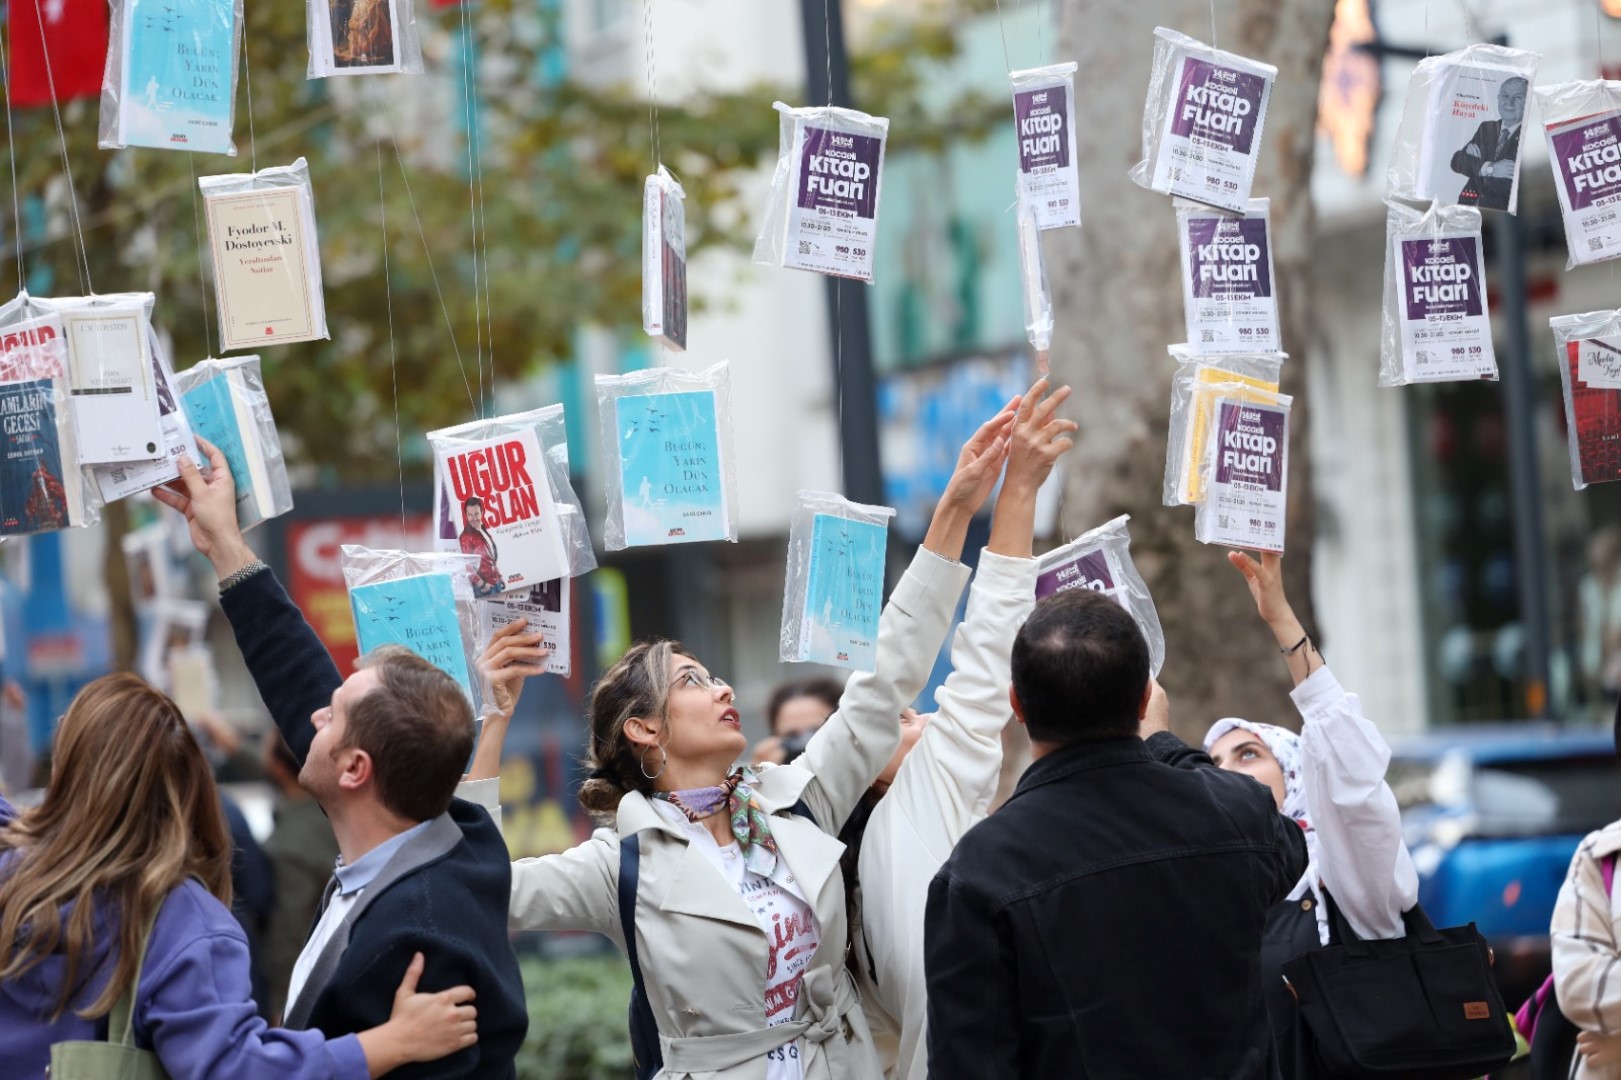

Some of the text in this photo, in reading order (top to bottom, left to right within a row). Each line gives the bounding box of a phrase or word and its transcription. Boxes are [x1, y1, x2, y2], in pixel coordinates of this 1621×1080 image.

[1186, 84, 1250, 116] Kitap
[1021, 113, 1062, 136] Kitap
[809, 154, 869, 182] Kitap
[1567, 142, 1621, 173] Kita
[1205, 175, 1238, 190] 980 530
[1573, 164, 1621, 193] Fua
[228, 223, 269, 239] Fyodor
[225, 233, 293, 251] Dostoyevski
[1198, 244, 1260, 264] Kitap
[1411, 263, 1471, 284] Kitap
[1255, 327, 1270, 335] 530
[1225, 430, 1276, 456] Kitap
[447, 440, 534, 502] UĞUR
[664, 483, 709, 494] OLACAK
[543, 641, 557, 650] 530
